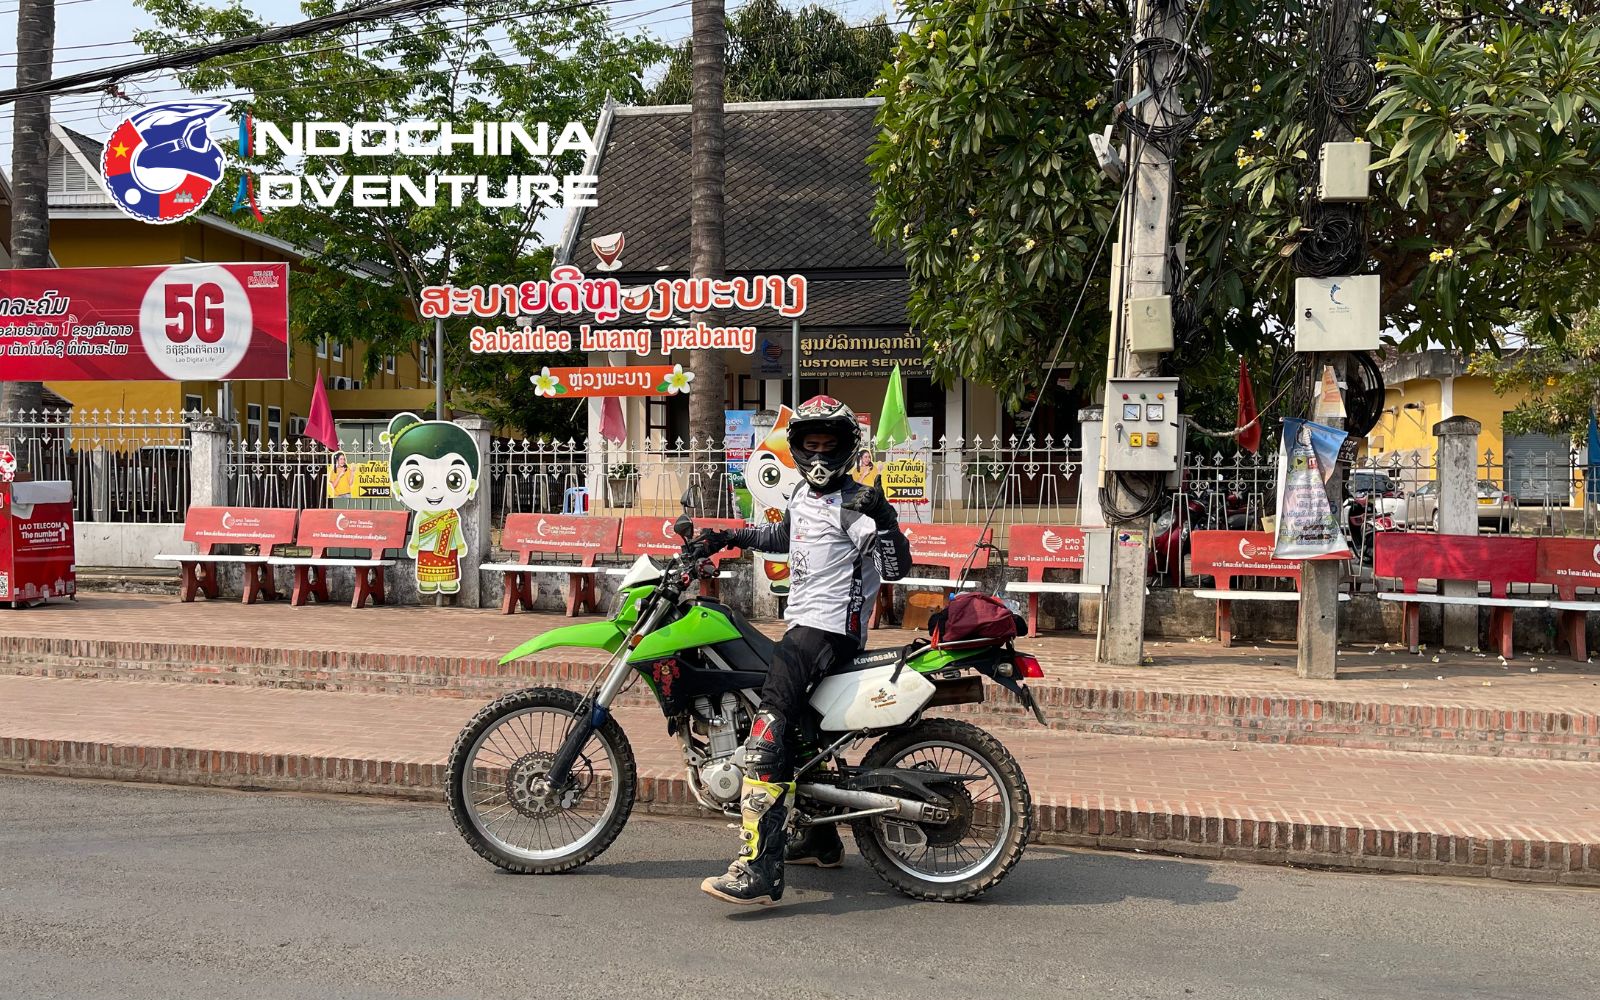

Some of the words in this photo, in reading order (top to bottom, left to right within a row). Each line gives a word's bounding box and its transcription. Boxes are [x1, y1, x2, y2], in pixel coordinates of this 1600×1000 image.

[164, 282, 225, 343] 5G
[470, 326, 571, 354] Sabaidee
[580, 323, 651, 356] Luang
[661, 322, 756, 356] prabang
[799, 359, 868, 368] USTOMER
[19, 523, 32, 531] LAO
[33, 521, 62, 530] TELECOM
[21, 531, 33, 539] The
[34, 530, 58, 538] number
[853, 651, 898, 666] Kawasaki
